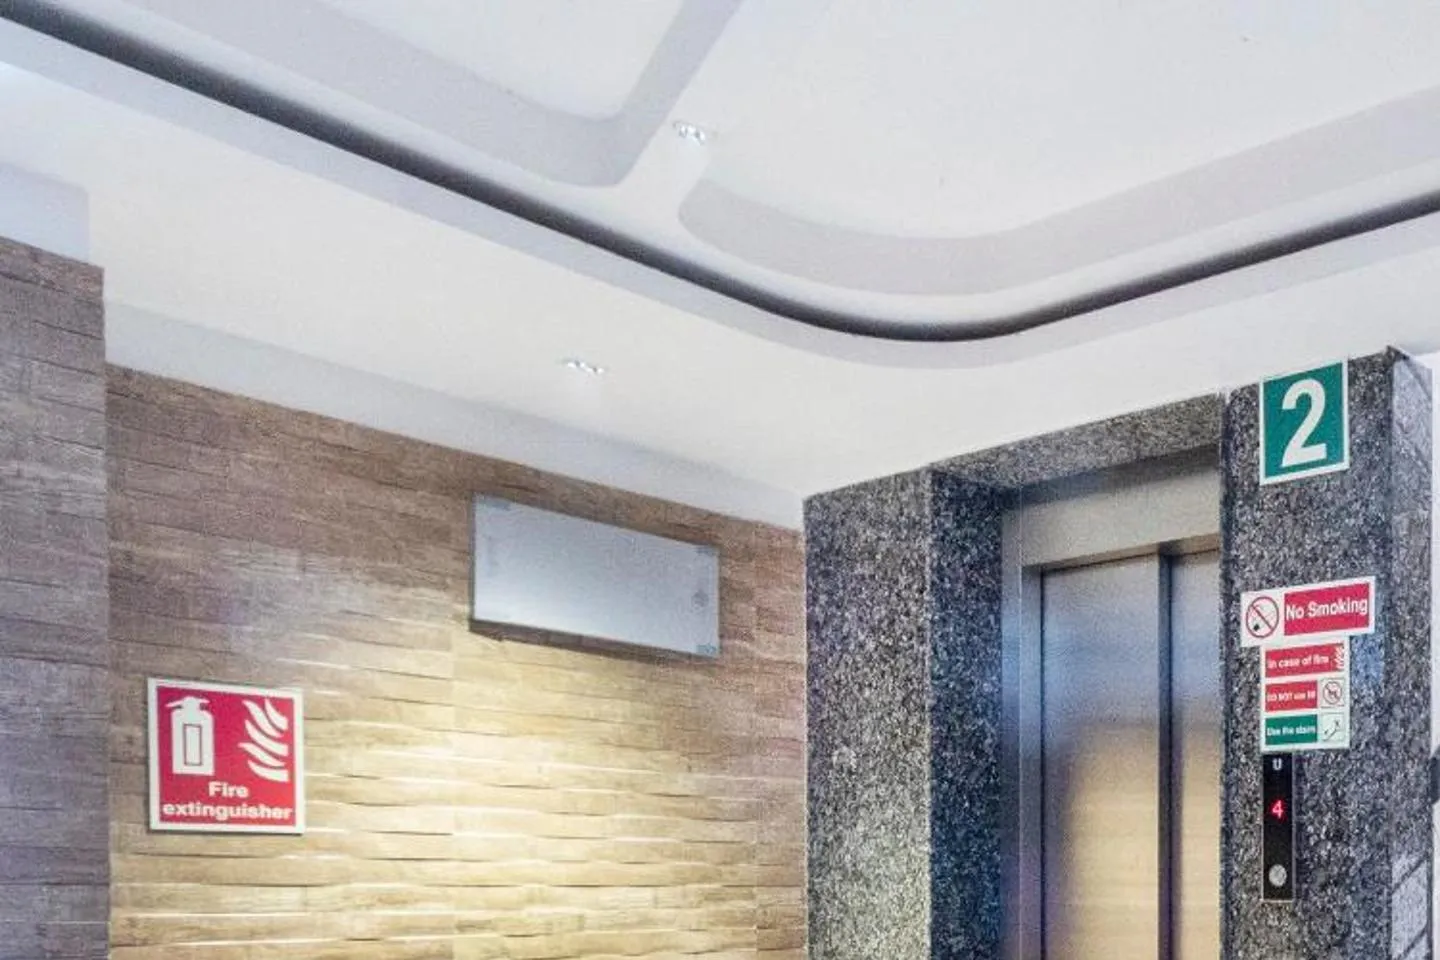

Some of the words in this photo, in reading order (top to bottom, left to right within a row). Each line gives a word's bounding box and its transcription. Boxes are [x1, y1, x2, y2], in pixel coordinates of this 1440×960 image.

[1281, 378, 1327, 468] 2
[1286, 603, 1304, 620] No
[1308, 597, 1368, 616] Smoking
[1278, 658, 1300, 669] case
[1301, 655, 1312, 666] of
[208, 781, 248, 798] Fire
[162, 801, 293, 821] extinguisher
[1271, 799, 1284, 819] 4
